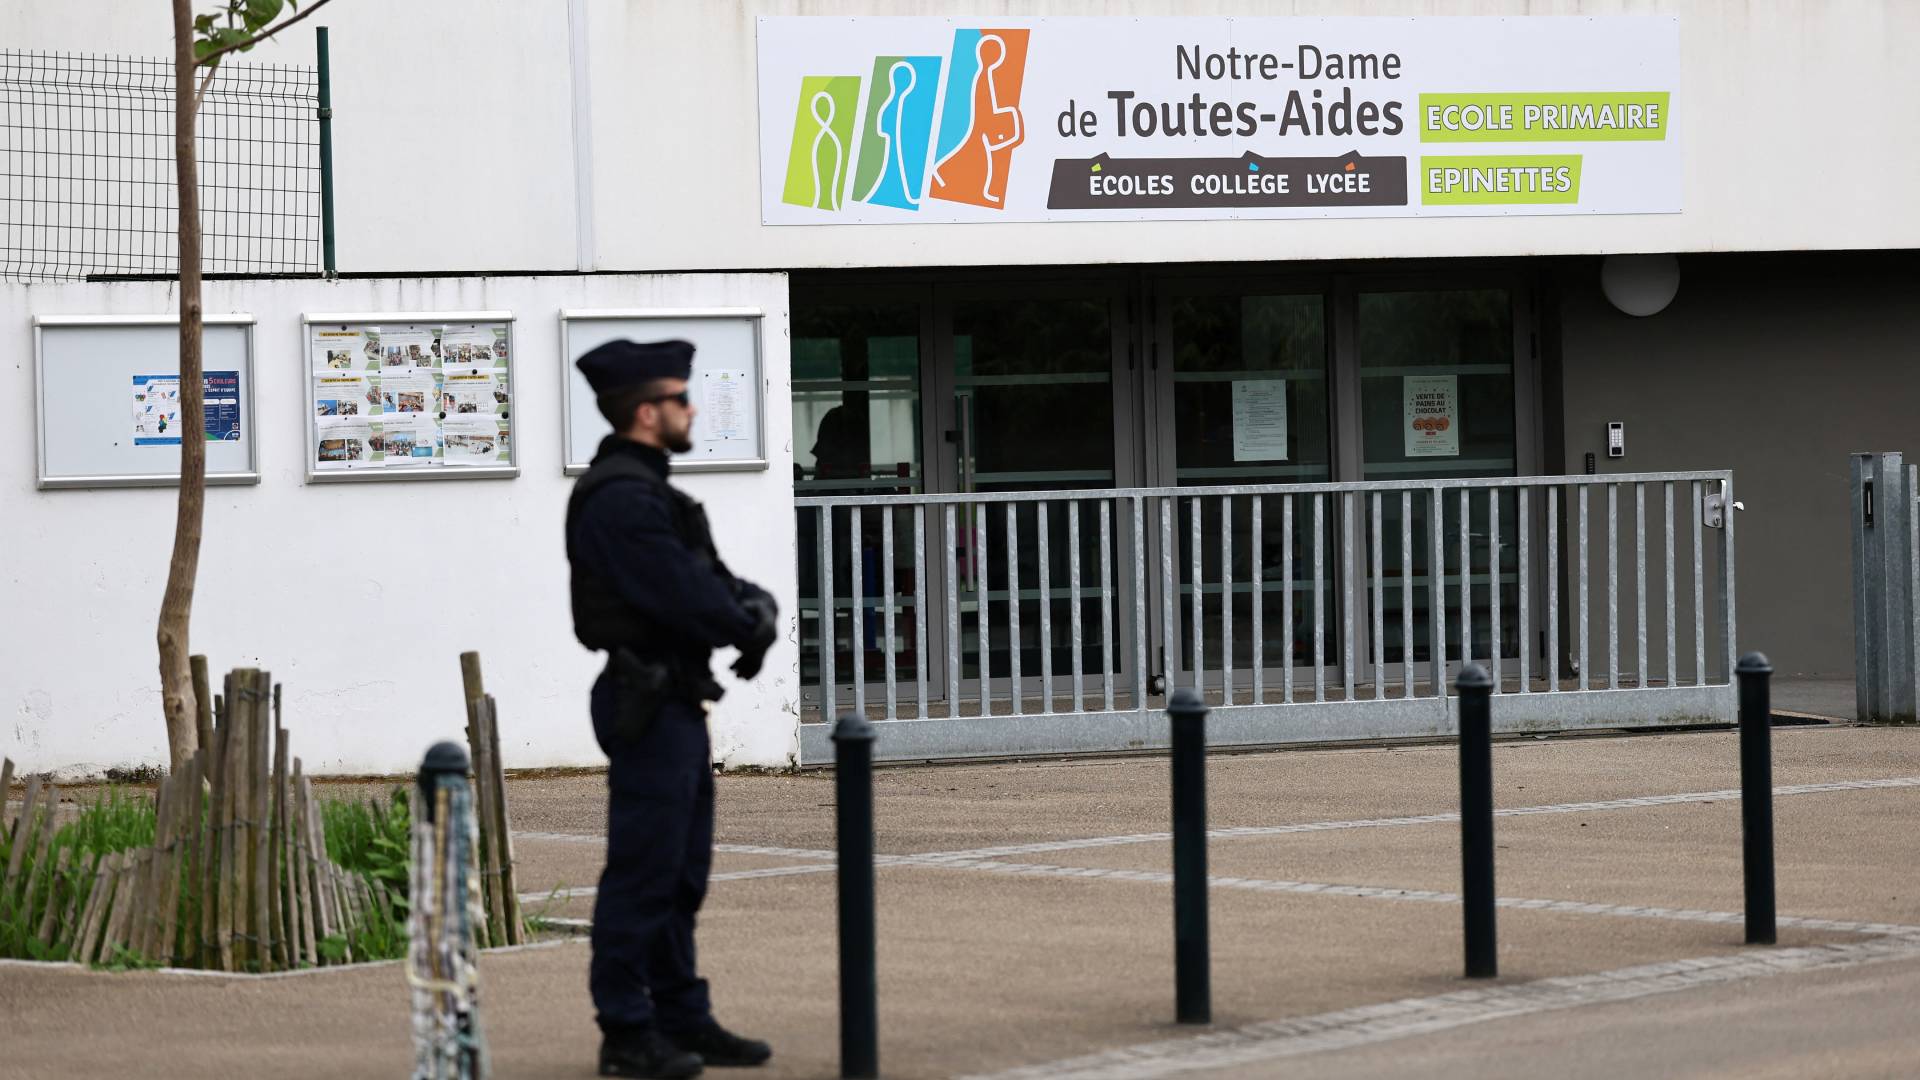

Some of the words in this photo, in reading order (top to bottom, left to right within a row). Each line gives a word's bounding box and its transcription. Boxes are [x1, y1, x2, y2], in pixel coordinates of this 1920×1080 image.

[1176, 44, 1401, 80] Notre-Dame
[1057, 99, 1098, 138] de
[1107, 86, 1404, 138] Toutes-Aides
[1426, 104, 1513, 131] ECOLE
[1523, 103, 1659, 130] PRIMAIRE
[1428, 166, 1572, 193] EPINETTES
